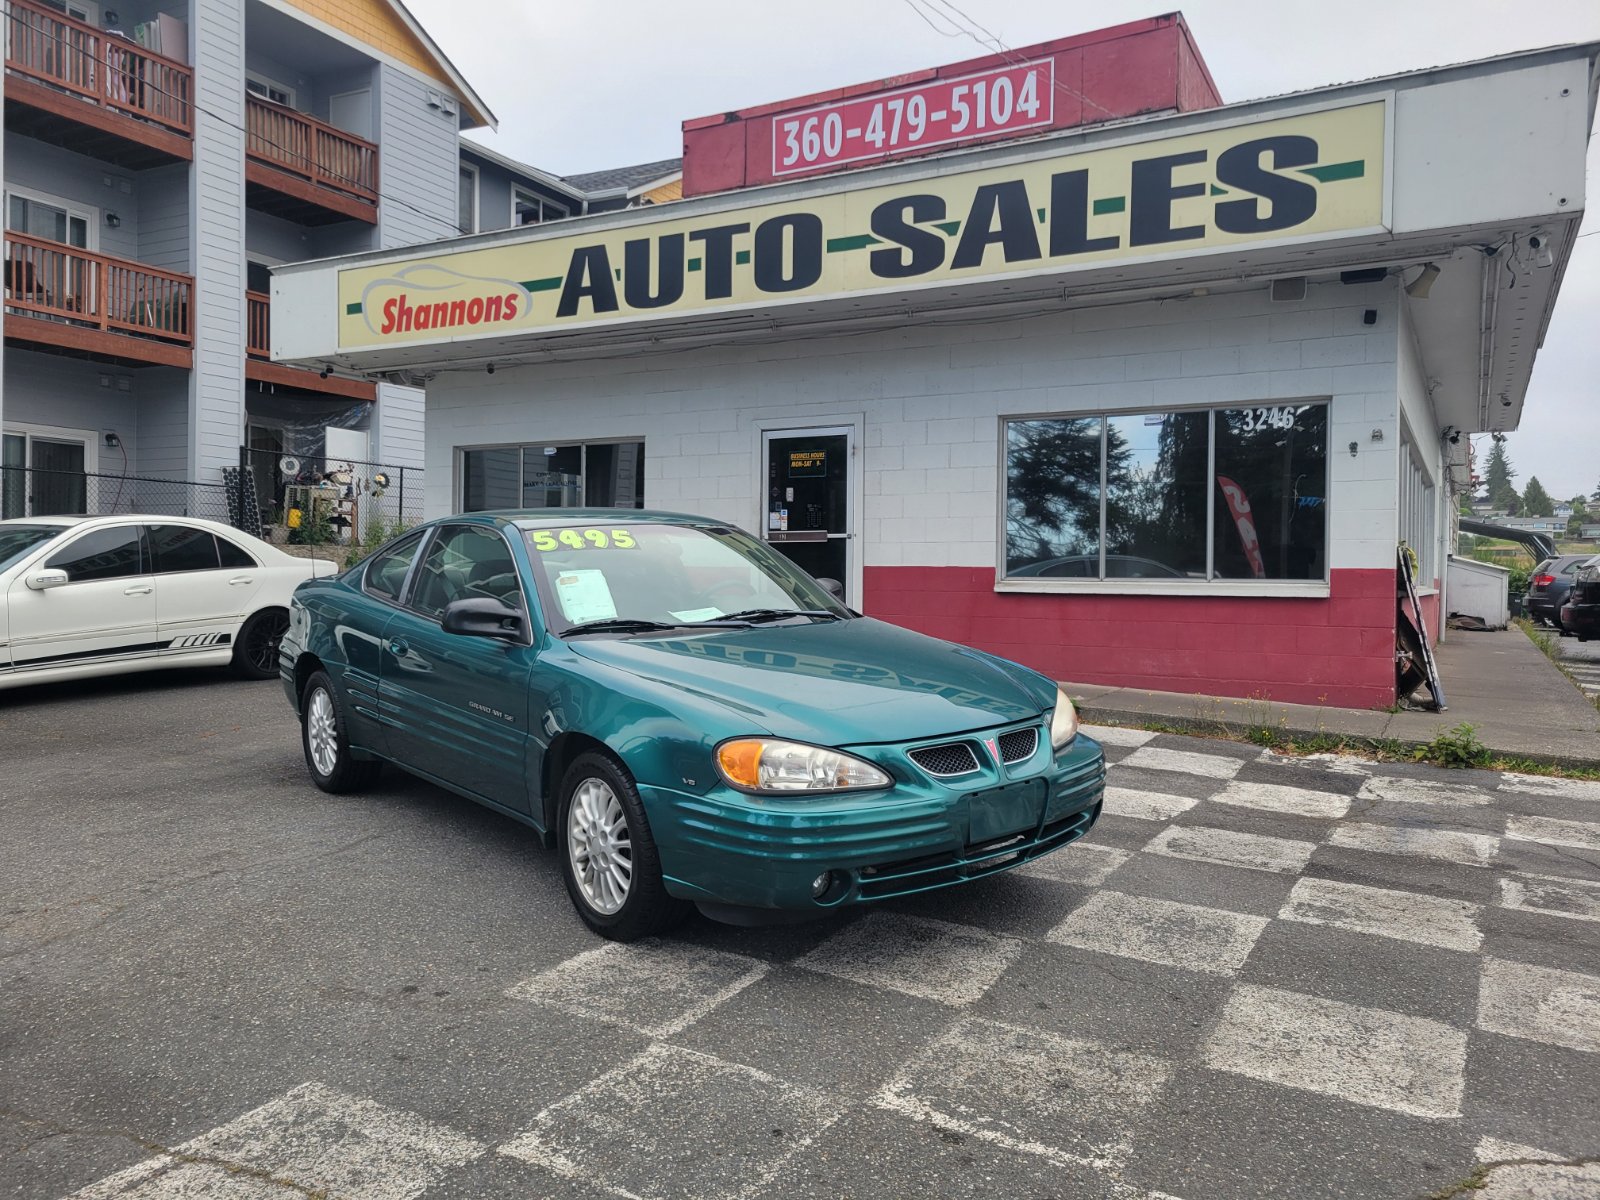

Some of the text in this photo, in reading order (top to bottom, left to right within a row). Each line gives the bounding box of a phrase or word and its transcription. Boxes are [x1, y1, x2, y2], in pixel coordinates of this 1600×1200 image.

[782, 70, 1041, 167] 360-479-5104
[381, 134, 1320, 336] Shannons AUTO SALES
[1242, 406, 1296, 431] 3246
[532, 529, 636, 551] 5495
[468, 701, 491, 713] GRAND
[682, 777, 696, 786] V6
